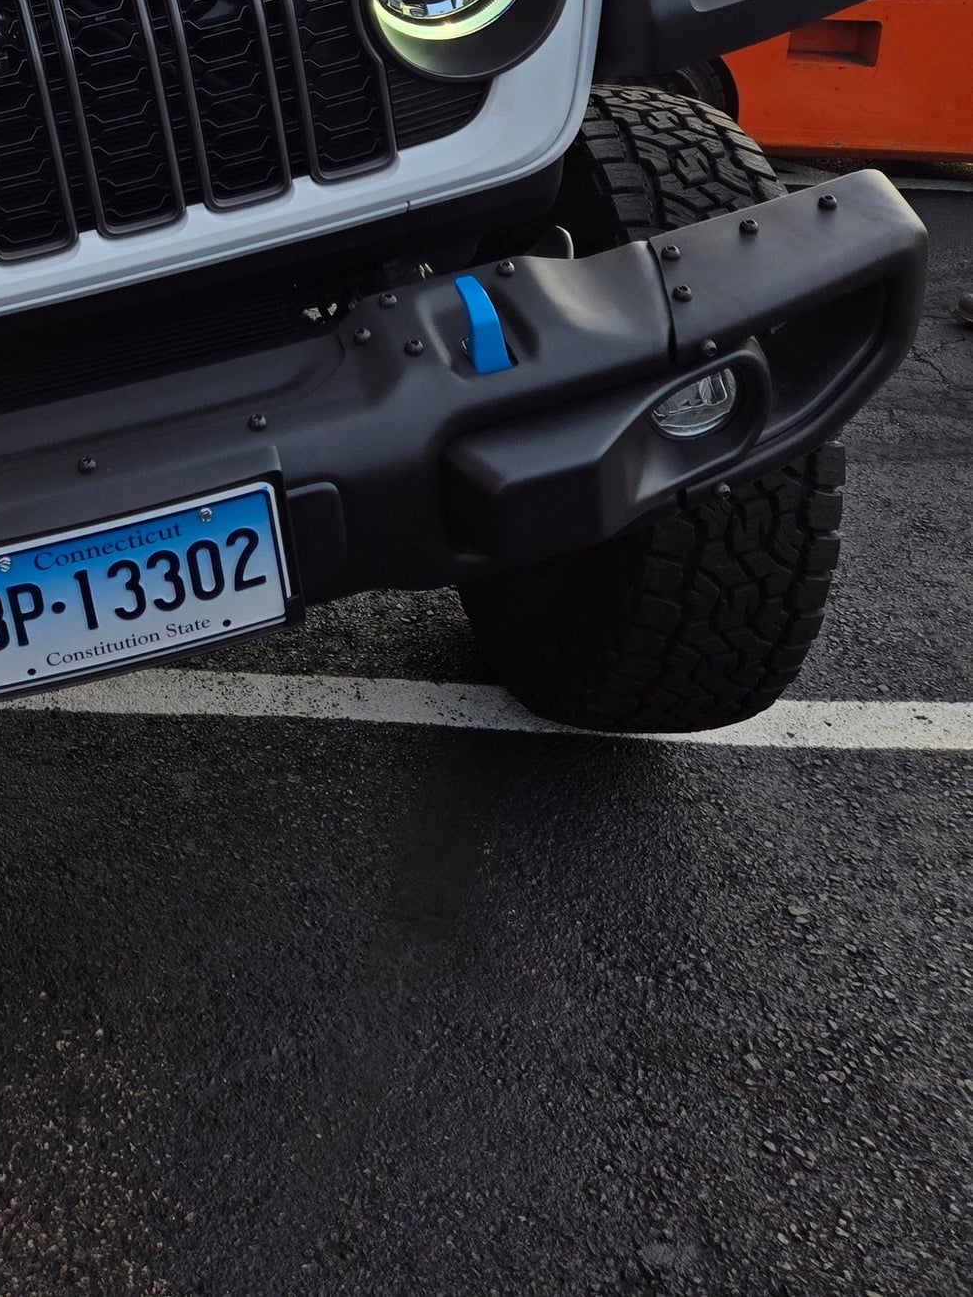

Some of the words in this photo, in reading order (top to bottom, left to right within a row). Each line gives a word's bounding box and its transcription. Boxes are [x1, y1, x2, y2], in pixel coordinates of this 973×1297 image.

[34, 523, 184, 572] Connecticut
[46, 632, 161, 668] Constitution
[165, 617, 212, 639] State
